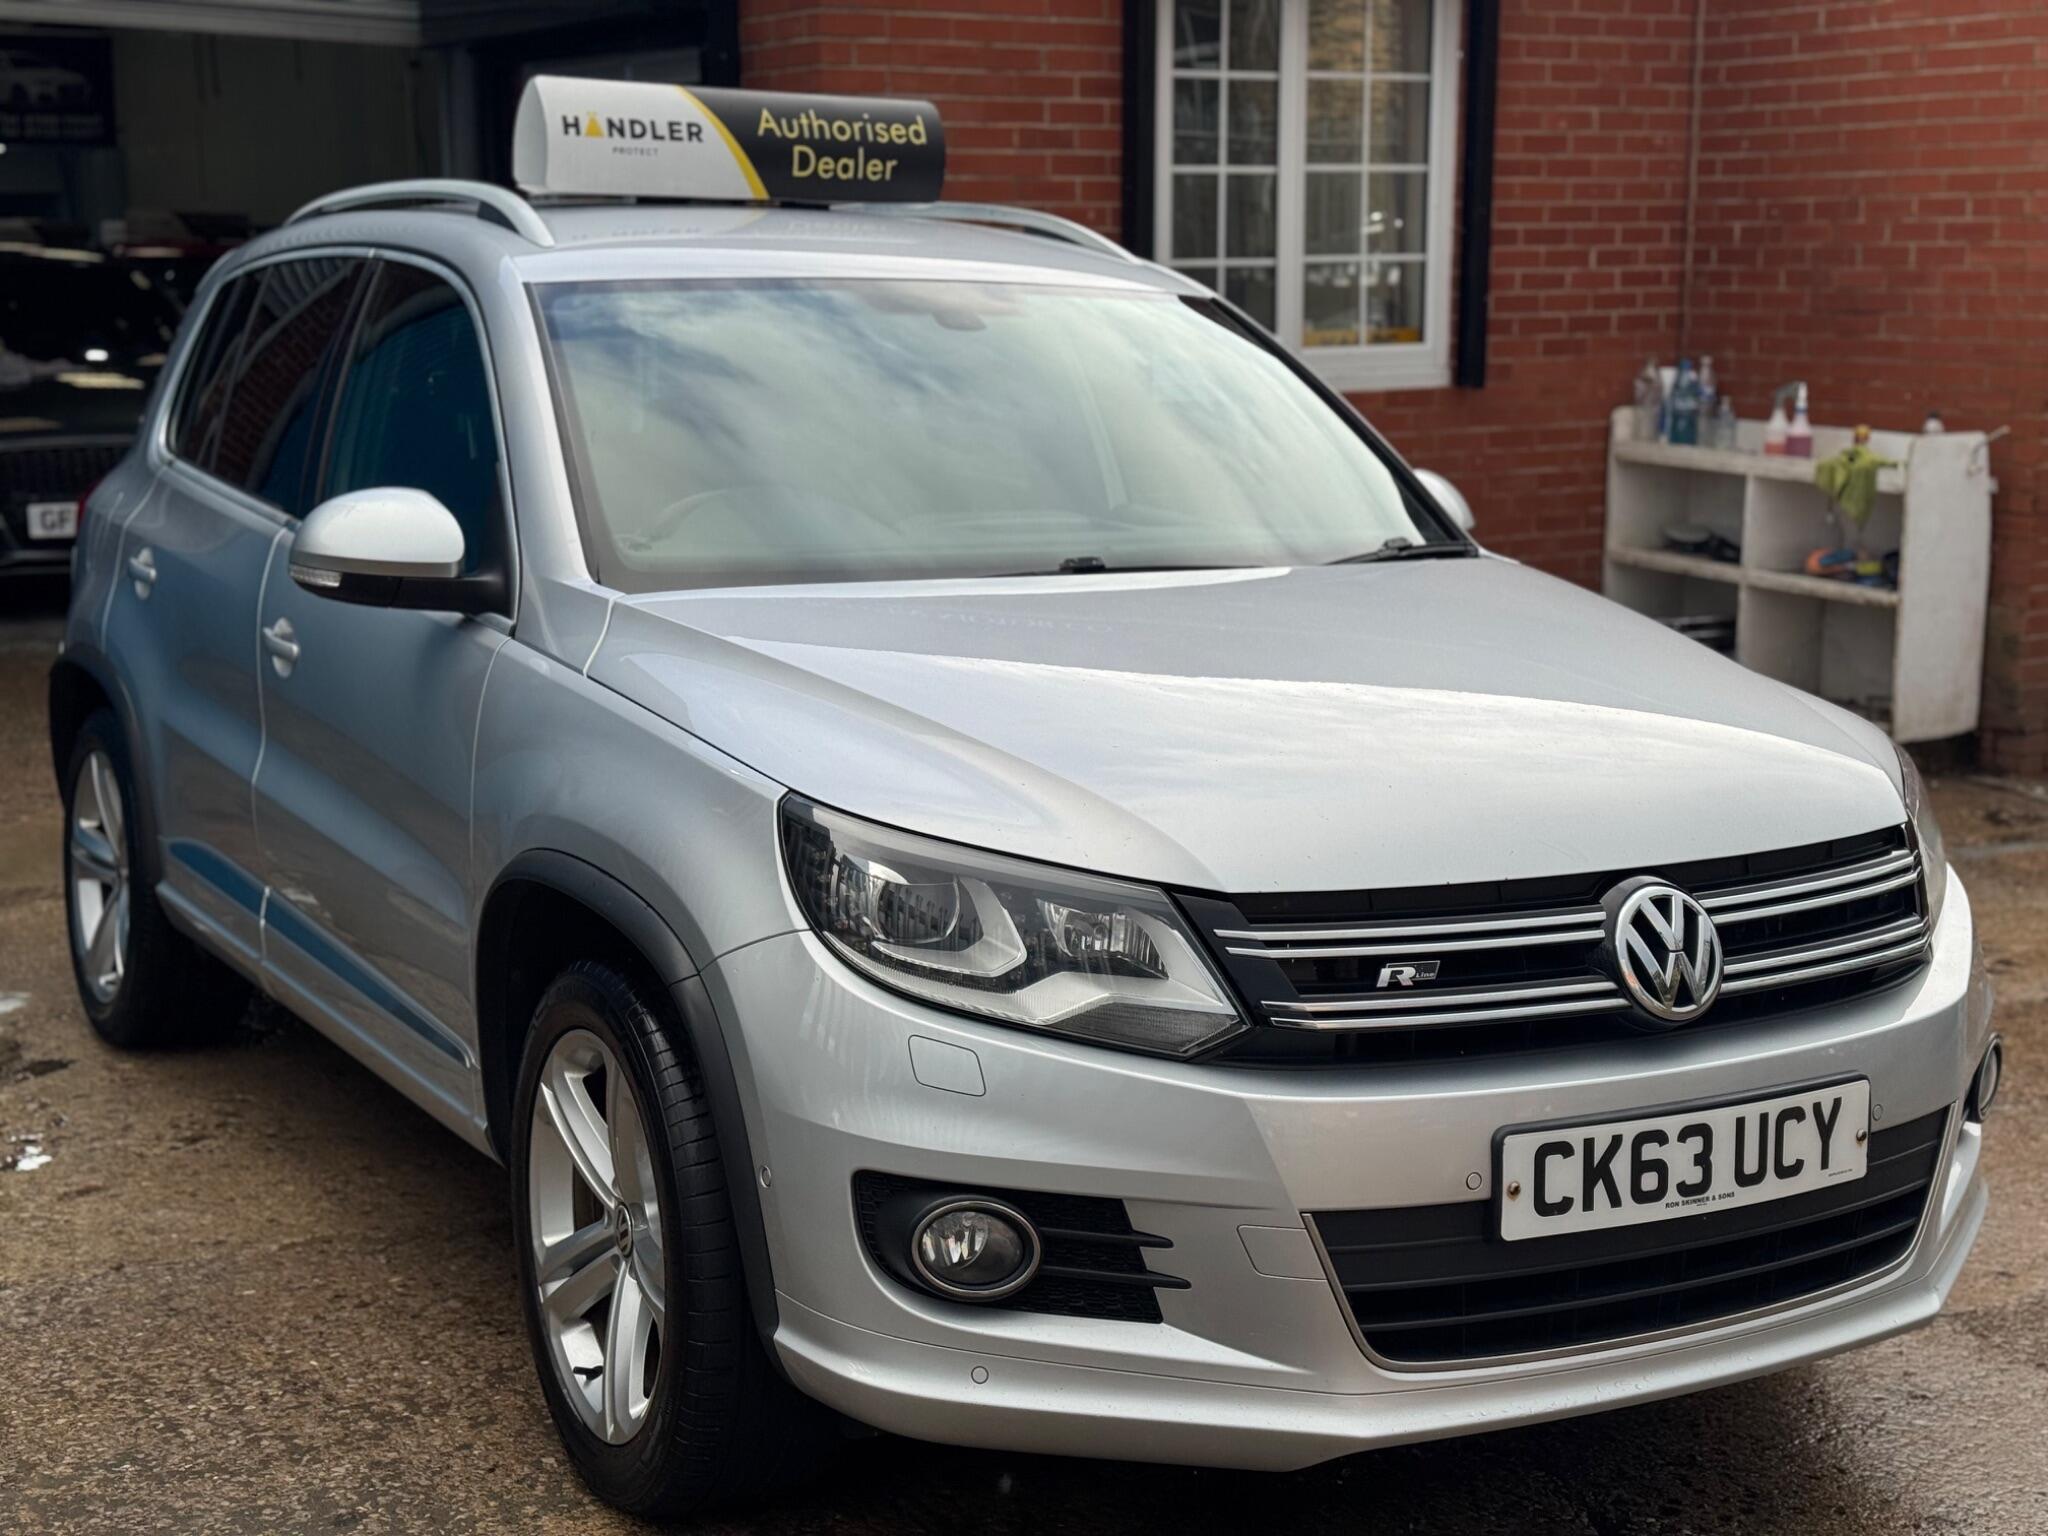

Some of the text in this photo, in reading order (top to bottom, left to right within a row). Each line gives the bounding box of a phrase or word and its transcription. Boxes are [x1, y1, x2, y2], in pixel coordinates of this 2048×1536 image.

[758, 108, 928, 145] Authorised
[612, 146, 659, 157] PROTECT
[792, 145, 898, 181] Dealer
[1534, 1096, 1843, 1217] CK63 UCY
[1665, 1201, 1680, 1209] RON
[1681, 1196, 1710, 1206] SKINNER
[1718, 1192, 1735, 1200] SONS
